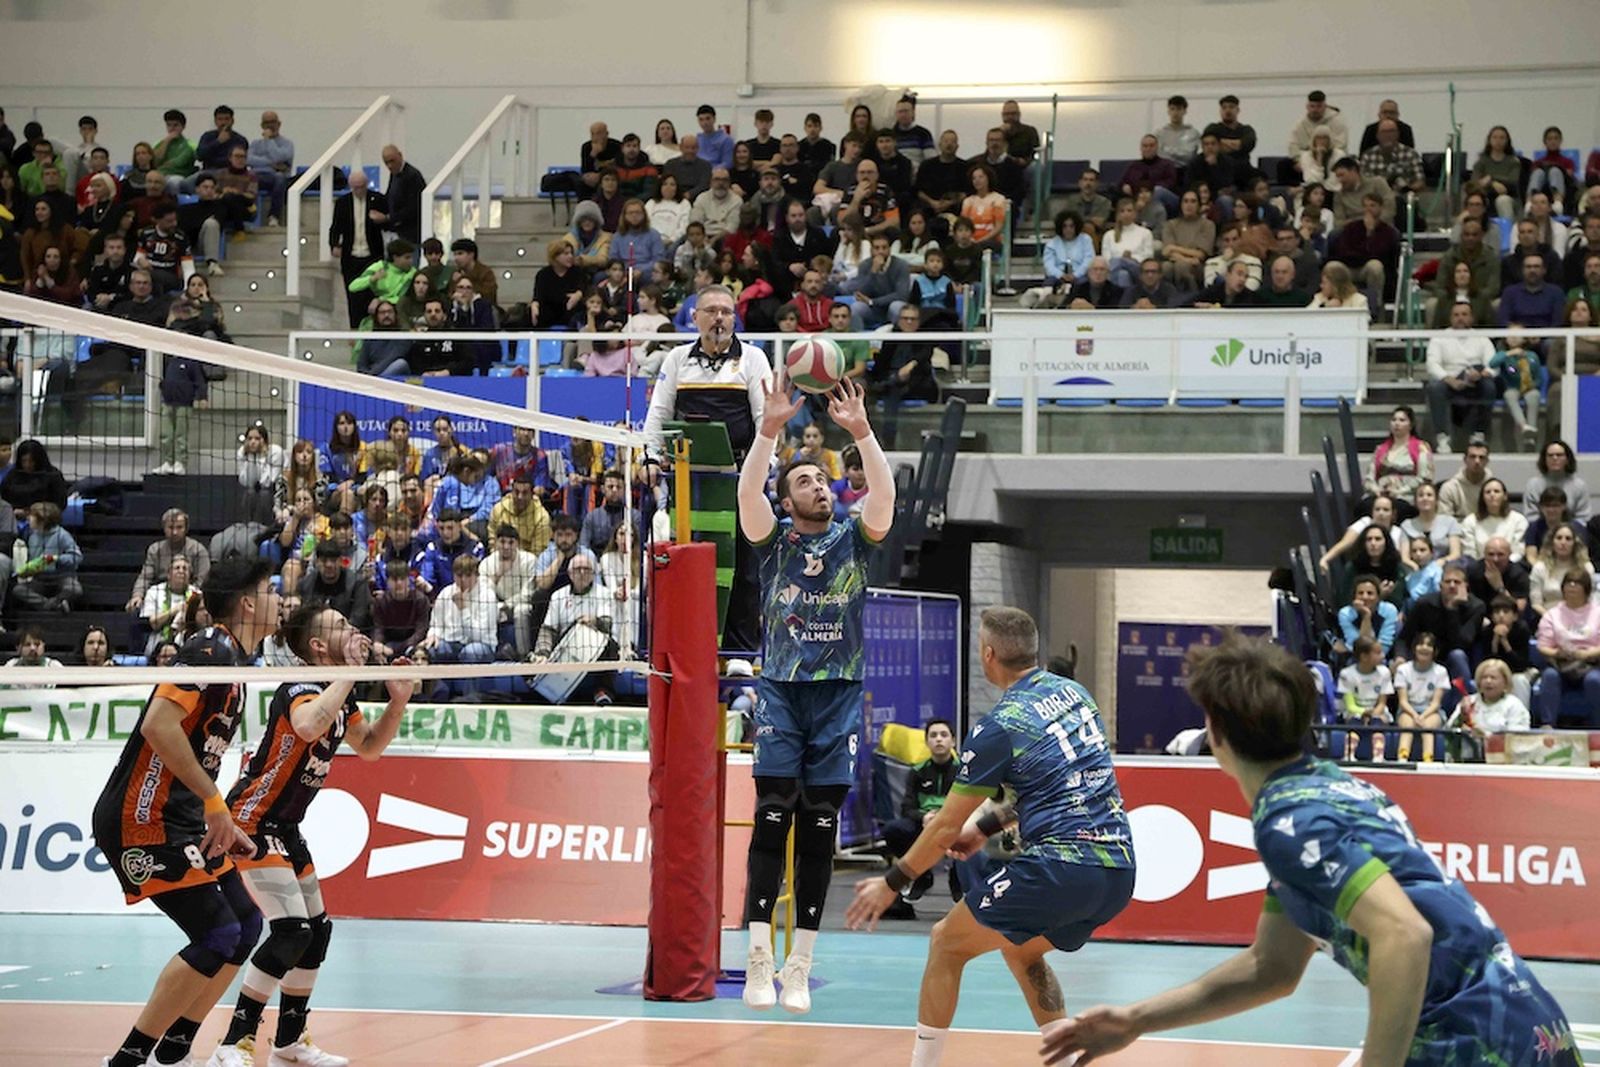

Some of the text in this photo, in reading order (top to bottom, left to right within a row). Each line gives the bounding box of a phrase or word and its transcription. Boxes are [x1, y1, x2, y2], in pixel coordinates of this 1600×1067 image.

[1019, 361, 1150, 371] DPUTACIÓN DE ALMERÍA
[1249, 348, 1323, 369] Unicaja
[1152, 536, 1220, 554] SALIDA
[1033, 686, 1083, 721] BORJA
[848, 734, 859, 756] 6
[1045, 706, 1106, 761] 14
[483, 821, 652, 863] SUPERLI
[184, 844, 205, 869] 9
[987, 866, 1012, 899] 14
